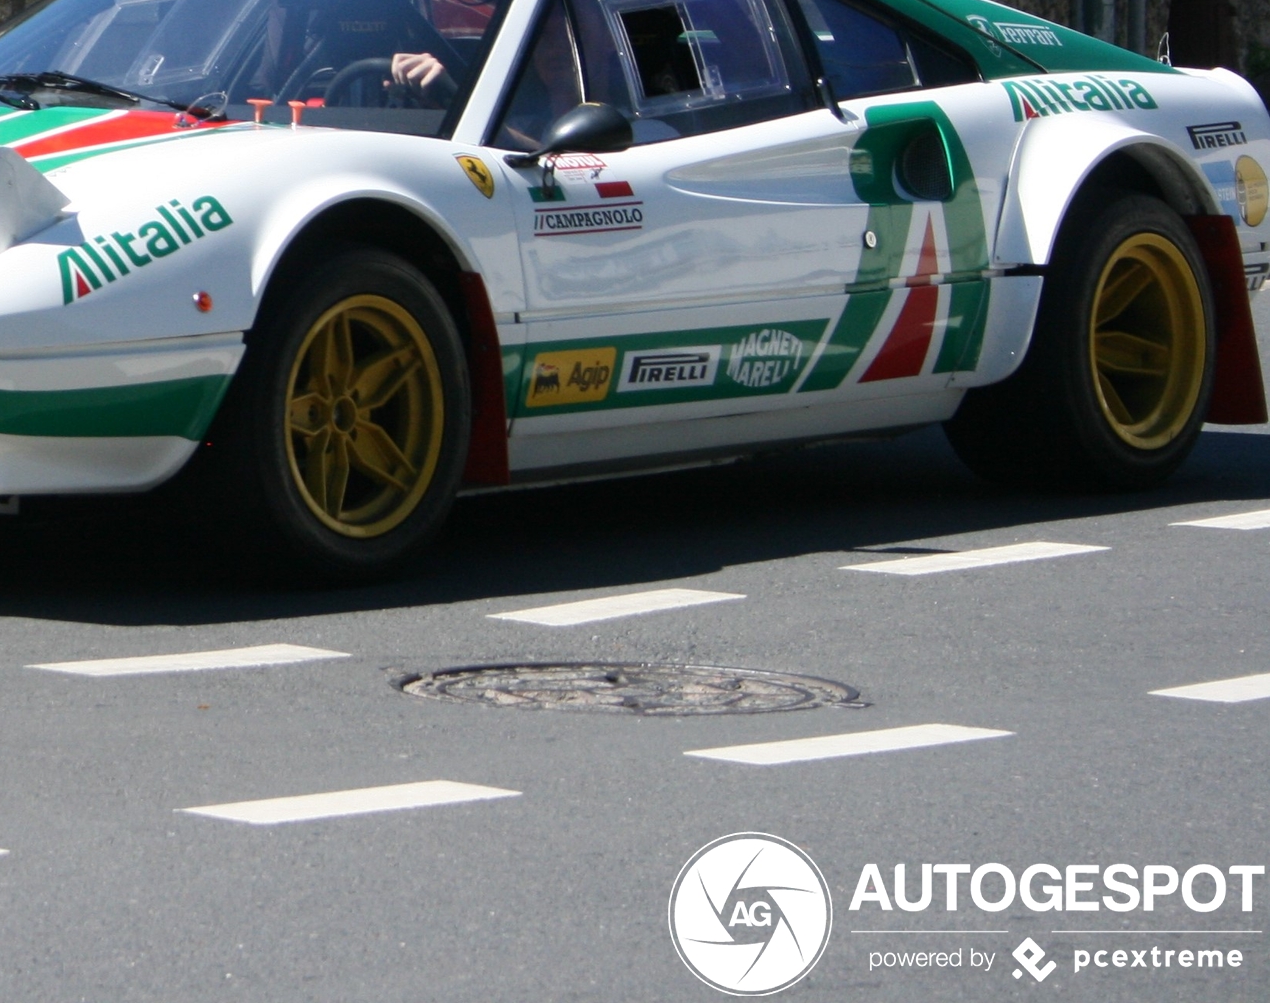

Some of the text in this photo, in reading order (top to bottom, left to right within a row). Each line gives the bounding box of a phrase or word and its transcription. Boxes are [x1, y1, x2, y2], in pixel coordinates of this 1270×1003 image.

[994, 21, 1063, 47] Ferrari
[1001, 74, 1159, 122] Alitalia
[1186, 121, 1248, 150] PIRELLI
[555, 155, 604, 169] MOTUL
[546, 208, 643, 229] CAMPAGNOLO
[57, 194, 234, 306] Alitalia
[567, 359, 610, 391] Agip
[628, 352, 710, 384] PIRELLI
